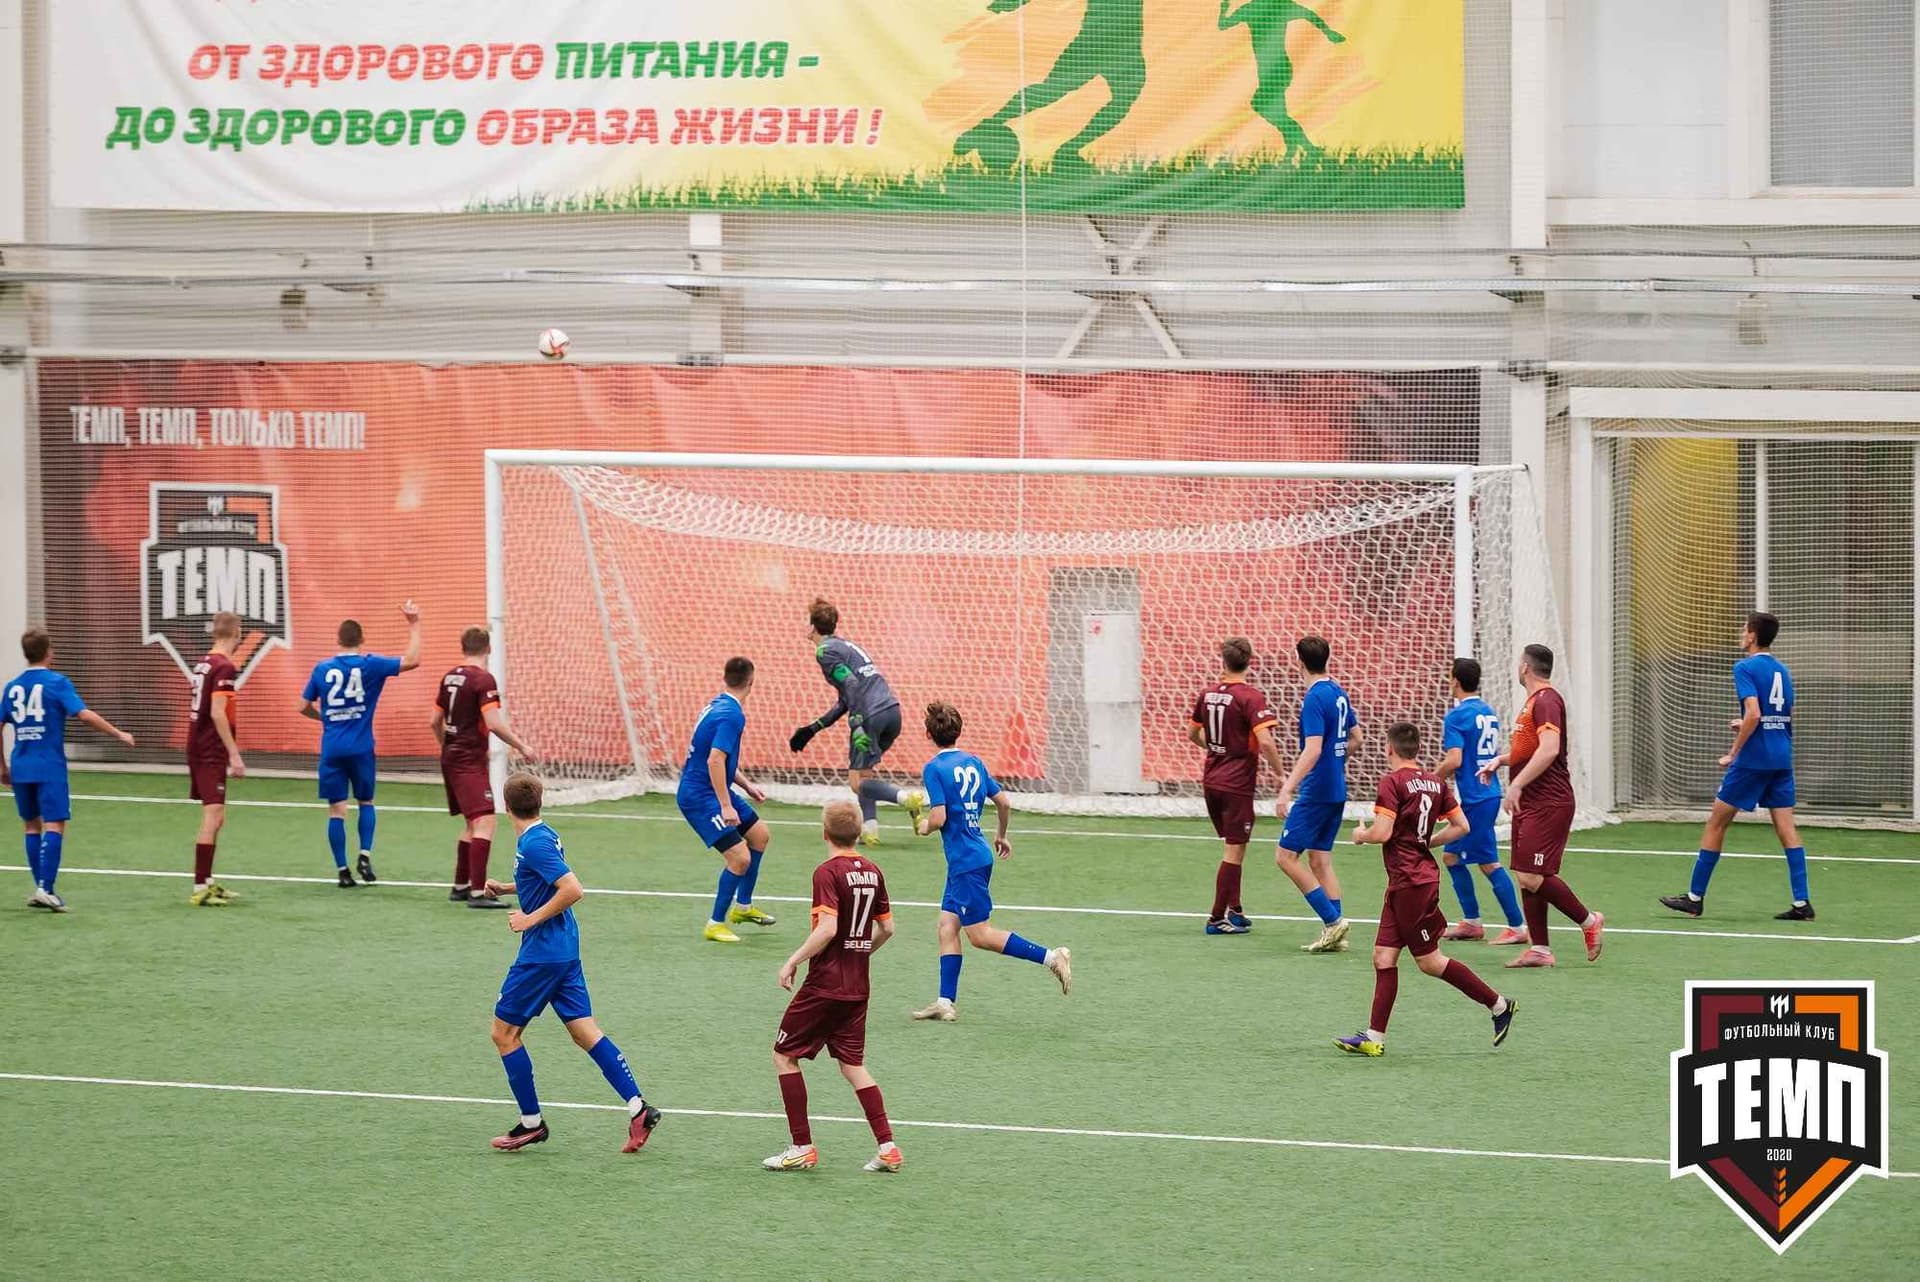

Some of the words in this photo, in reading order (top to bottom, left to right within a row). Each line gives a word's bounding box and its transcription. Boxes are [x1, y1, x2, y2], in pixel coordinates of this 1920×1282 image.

[188, 44, 251, 81] ОТ
[258, 43, 544, 88] ЗДОРОВОГО
[556, 41, 789, 79] ПИТАНИЯ
[105, 107, 176, 151] ДО
[183, 108, 466, 152] ЗДОРОВОГО
[476, 108, 660, 145] ОБРАЗА
[69, 406, 131, 449] ТЕМП,
[137, 407, 204, 449] ТЕМП,
[209, 408, 295, 449] ТОЛЬКО
[302, 410, 366, 449] ТЕМП!
[157, 546, 277, 625] ТЕМП
[8, 684, 46, 723] 34
[325, 667, 366, 706] 24
[447, 686, 458, 724] 7
[1769, 671, 1785, 712] 4
[1207, 704, 1225, 745] 11
[1476, 714, 1498, 755] 25
[953, 765, 980, 810] 22
[1417, 793, 1433, 836] 8
[1534, 853, 1545, 866] 13
[849, 887, 876, 938] 17
[1420, 929, 1430, 942] 8
